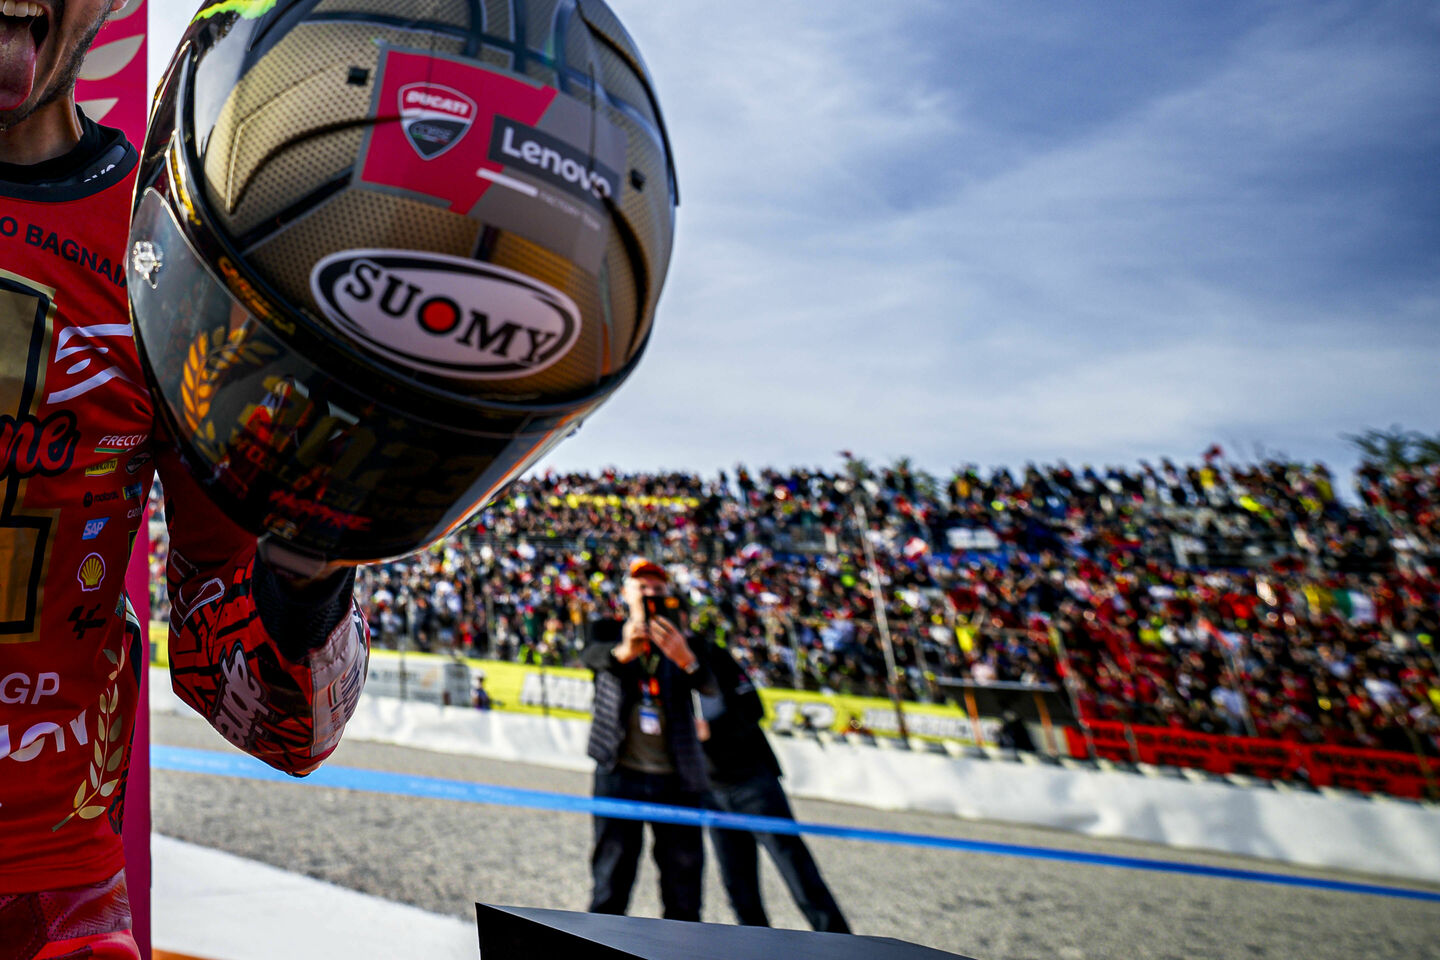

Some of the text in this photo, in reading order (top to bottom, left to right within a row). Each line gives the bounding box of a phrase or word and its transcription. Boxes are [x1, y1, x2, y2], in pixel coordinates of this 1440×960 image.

[406, 89, 469, 116] DUCATI
[501, 126, 613, 200] Lenovo
[345, 258, 556, 366] SUOMY
[83, 521, 105, 537] SAP
